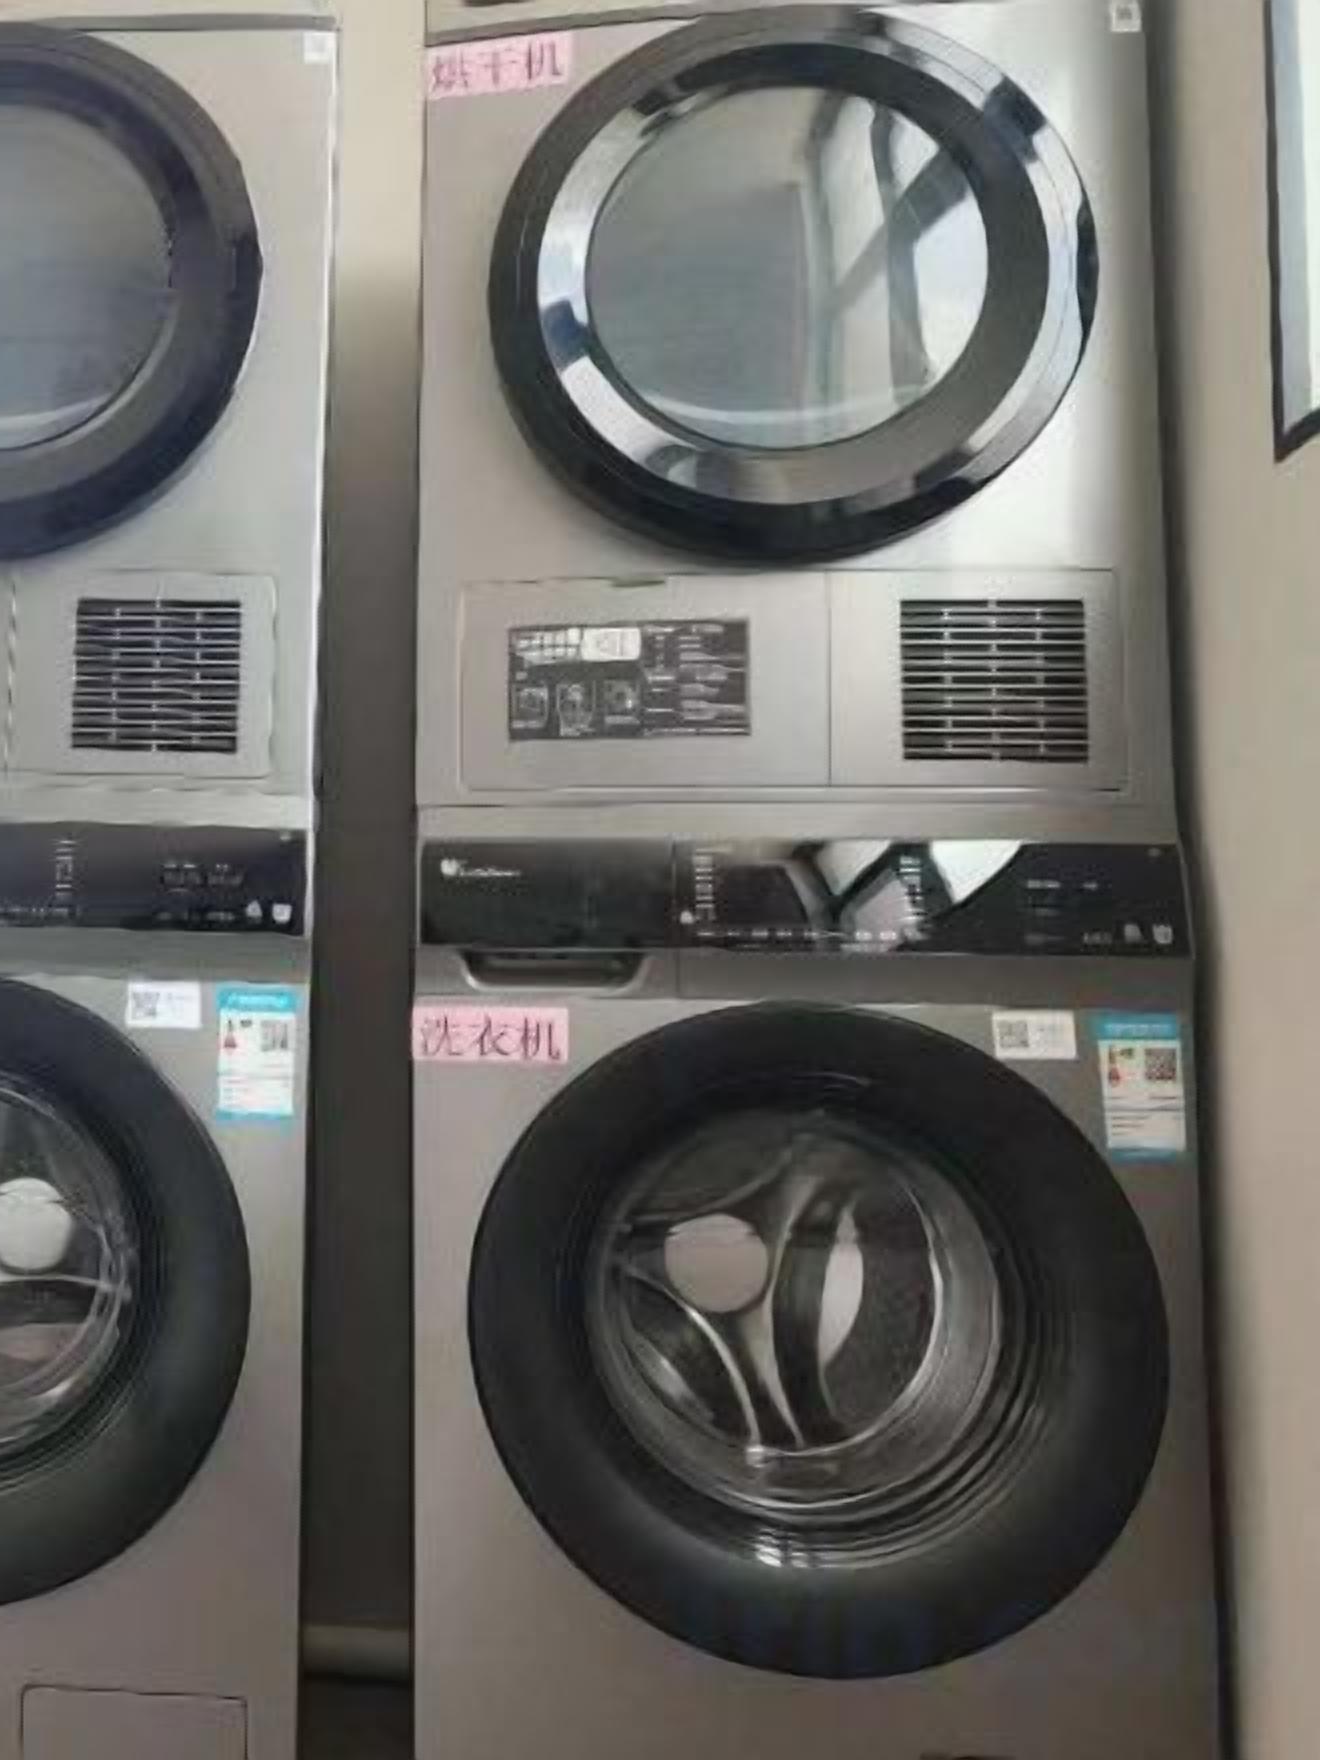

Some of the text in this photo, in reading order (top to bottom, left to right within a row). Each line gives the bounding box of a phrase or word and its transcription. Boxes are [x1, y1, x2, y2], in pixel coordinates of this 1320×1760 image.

[432, 41, 562, 92] 烘干机
[420, 1015, 561, 1060] 洗衣机
